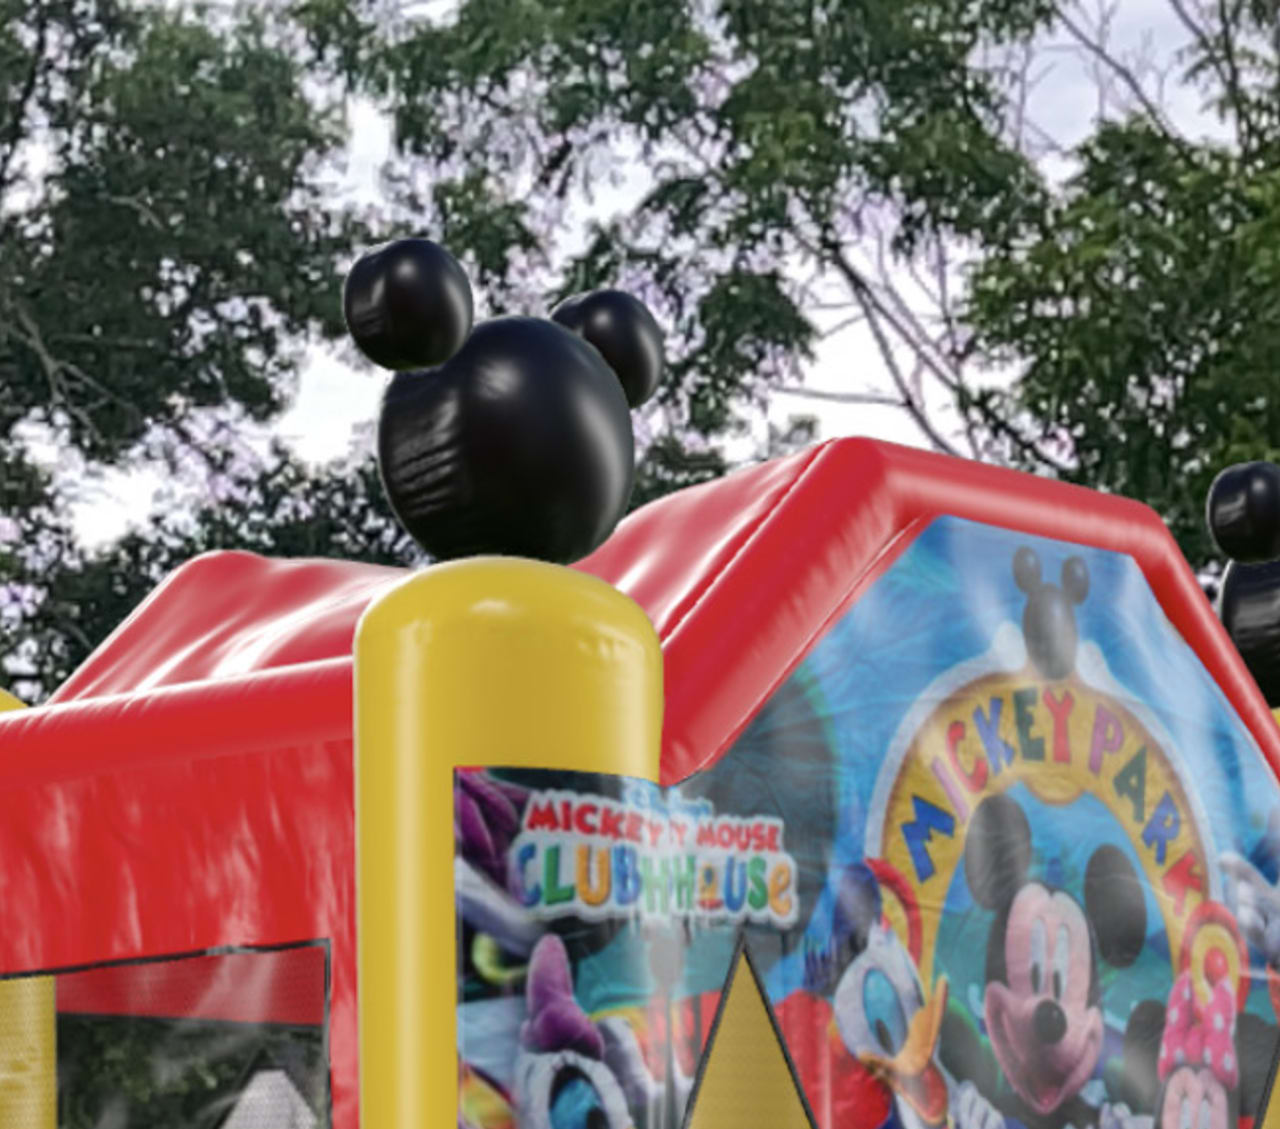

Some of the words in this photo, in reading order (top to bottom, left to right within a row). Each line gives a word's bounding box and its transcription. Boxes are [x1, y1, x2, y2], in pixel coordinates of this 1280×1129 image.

[696, 818, 781, 853] MOUSE
[901, 688, 1074, 883] MICKEY
[1087, 702, 1204, 916] PARK
